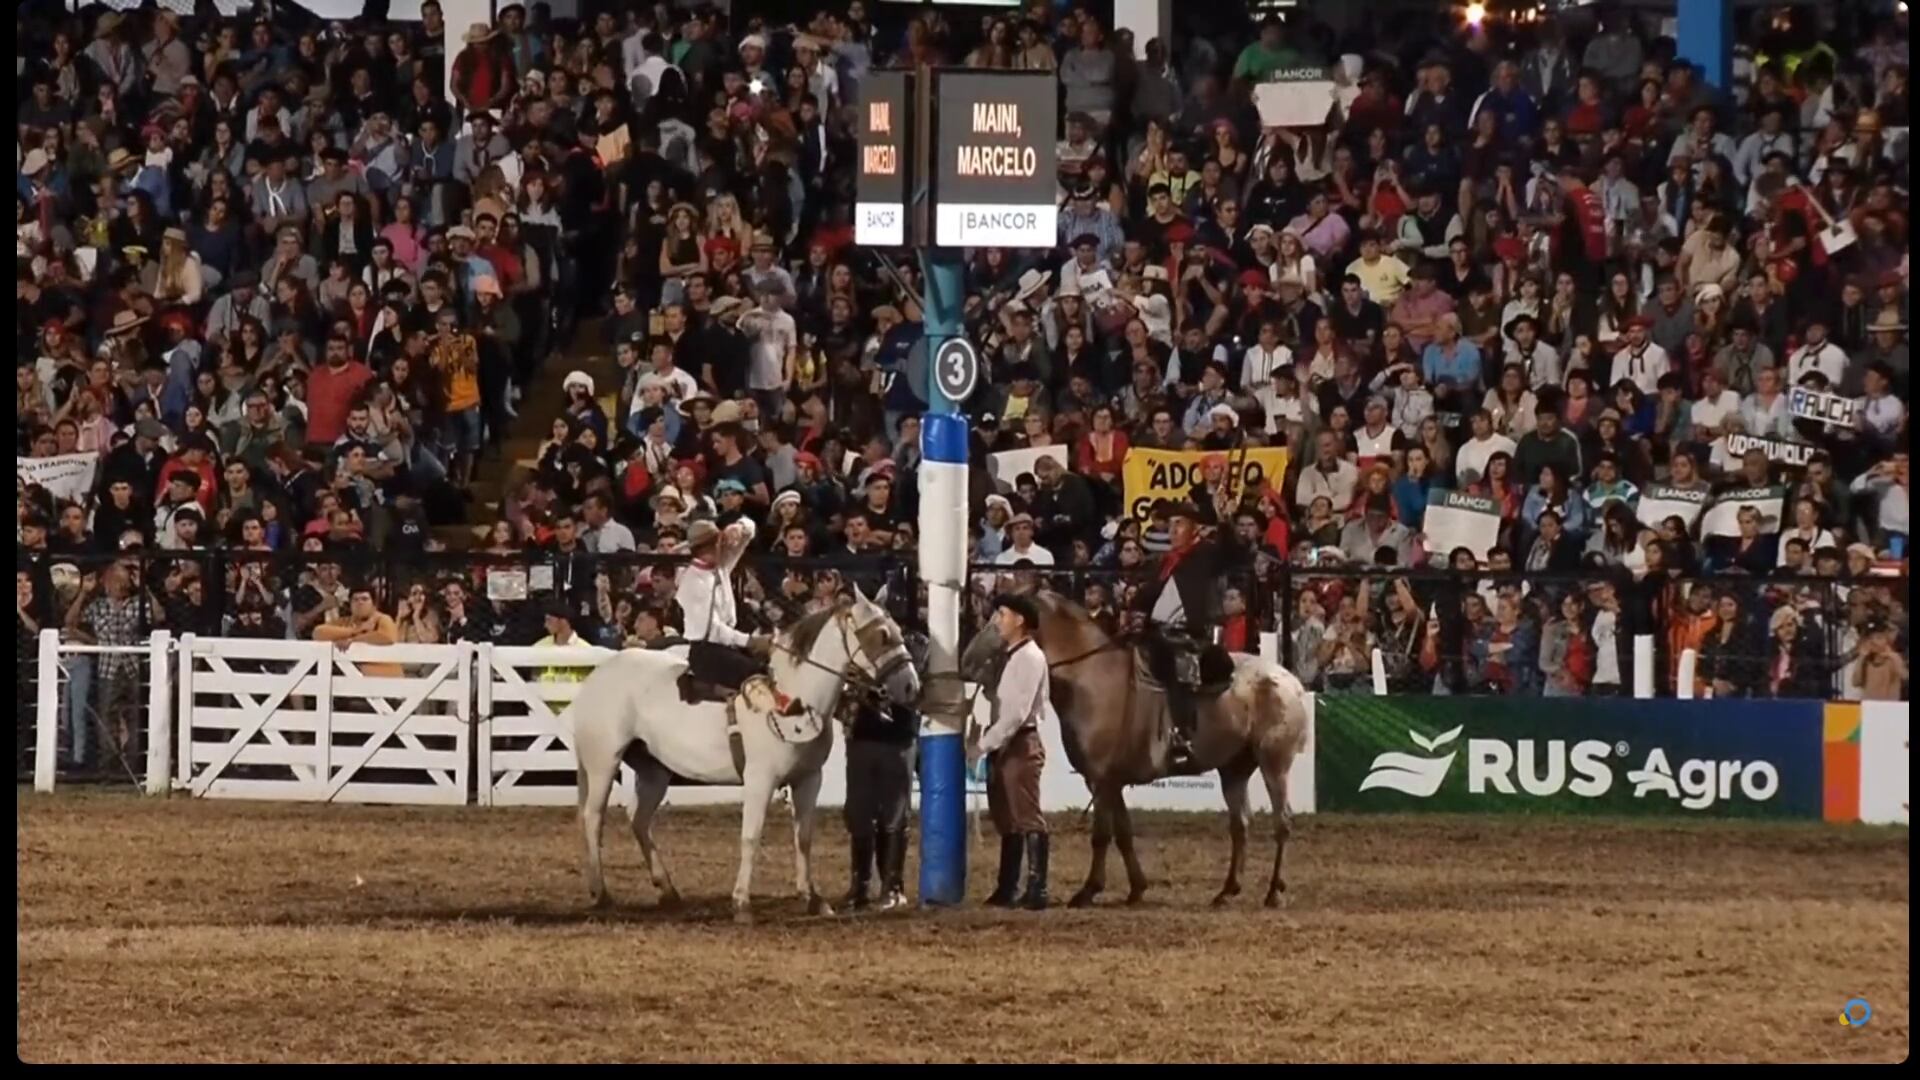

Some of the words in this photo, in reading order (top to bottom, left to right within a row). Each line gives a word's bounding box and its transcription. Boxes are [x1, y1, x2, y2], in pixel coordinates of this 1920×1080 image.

[1275, 68, 1322, 79] BANCOR
[973, 103, 1021, 138] MAINI,
[864, 145, 896, 174] MARCELO
[957, 146, 1036, 177] MARCELO
[867, 210, 895, 228] BANCOR
[966, 212, 1037, 230] BANCOR
[947, 352, 965, 386] 3
[1791, 389, 1853, 423] RAUCH
[1449, 493, 1492, 510] BANCOR
[1627, 748, 1779, 810] Agro
